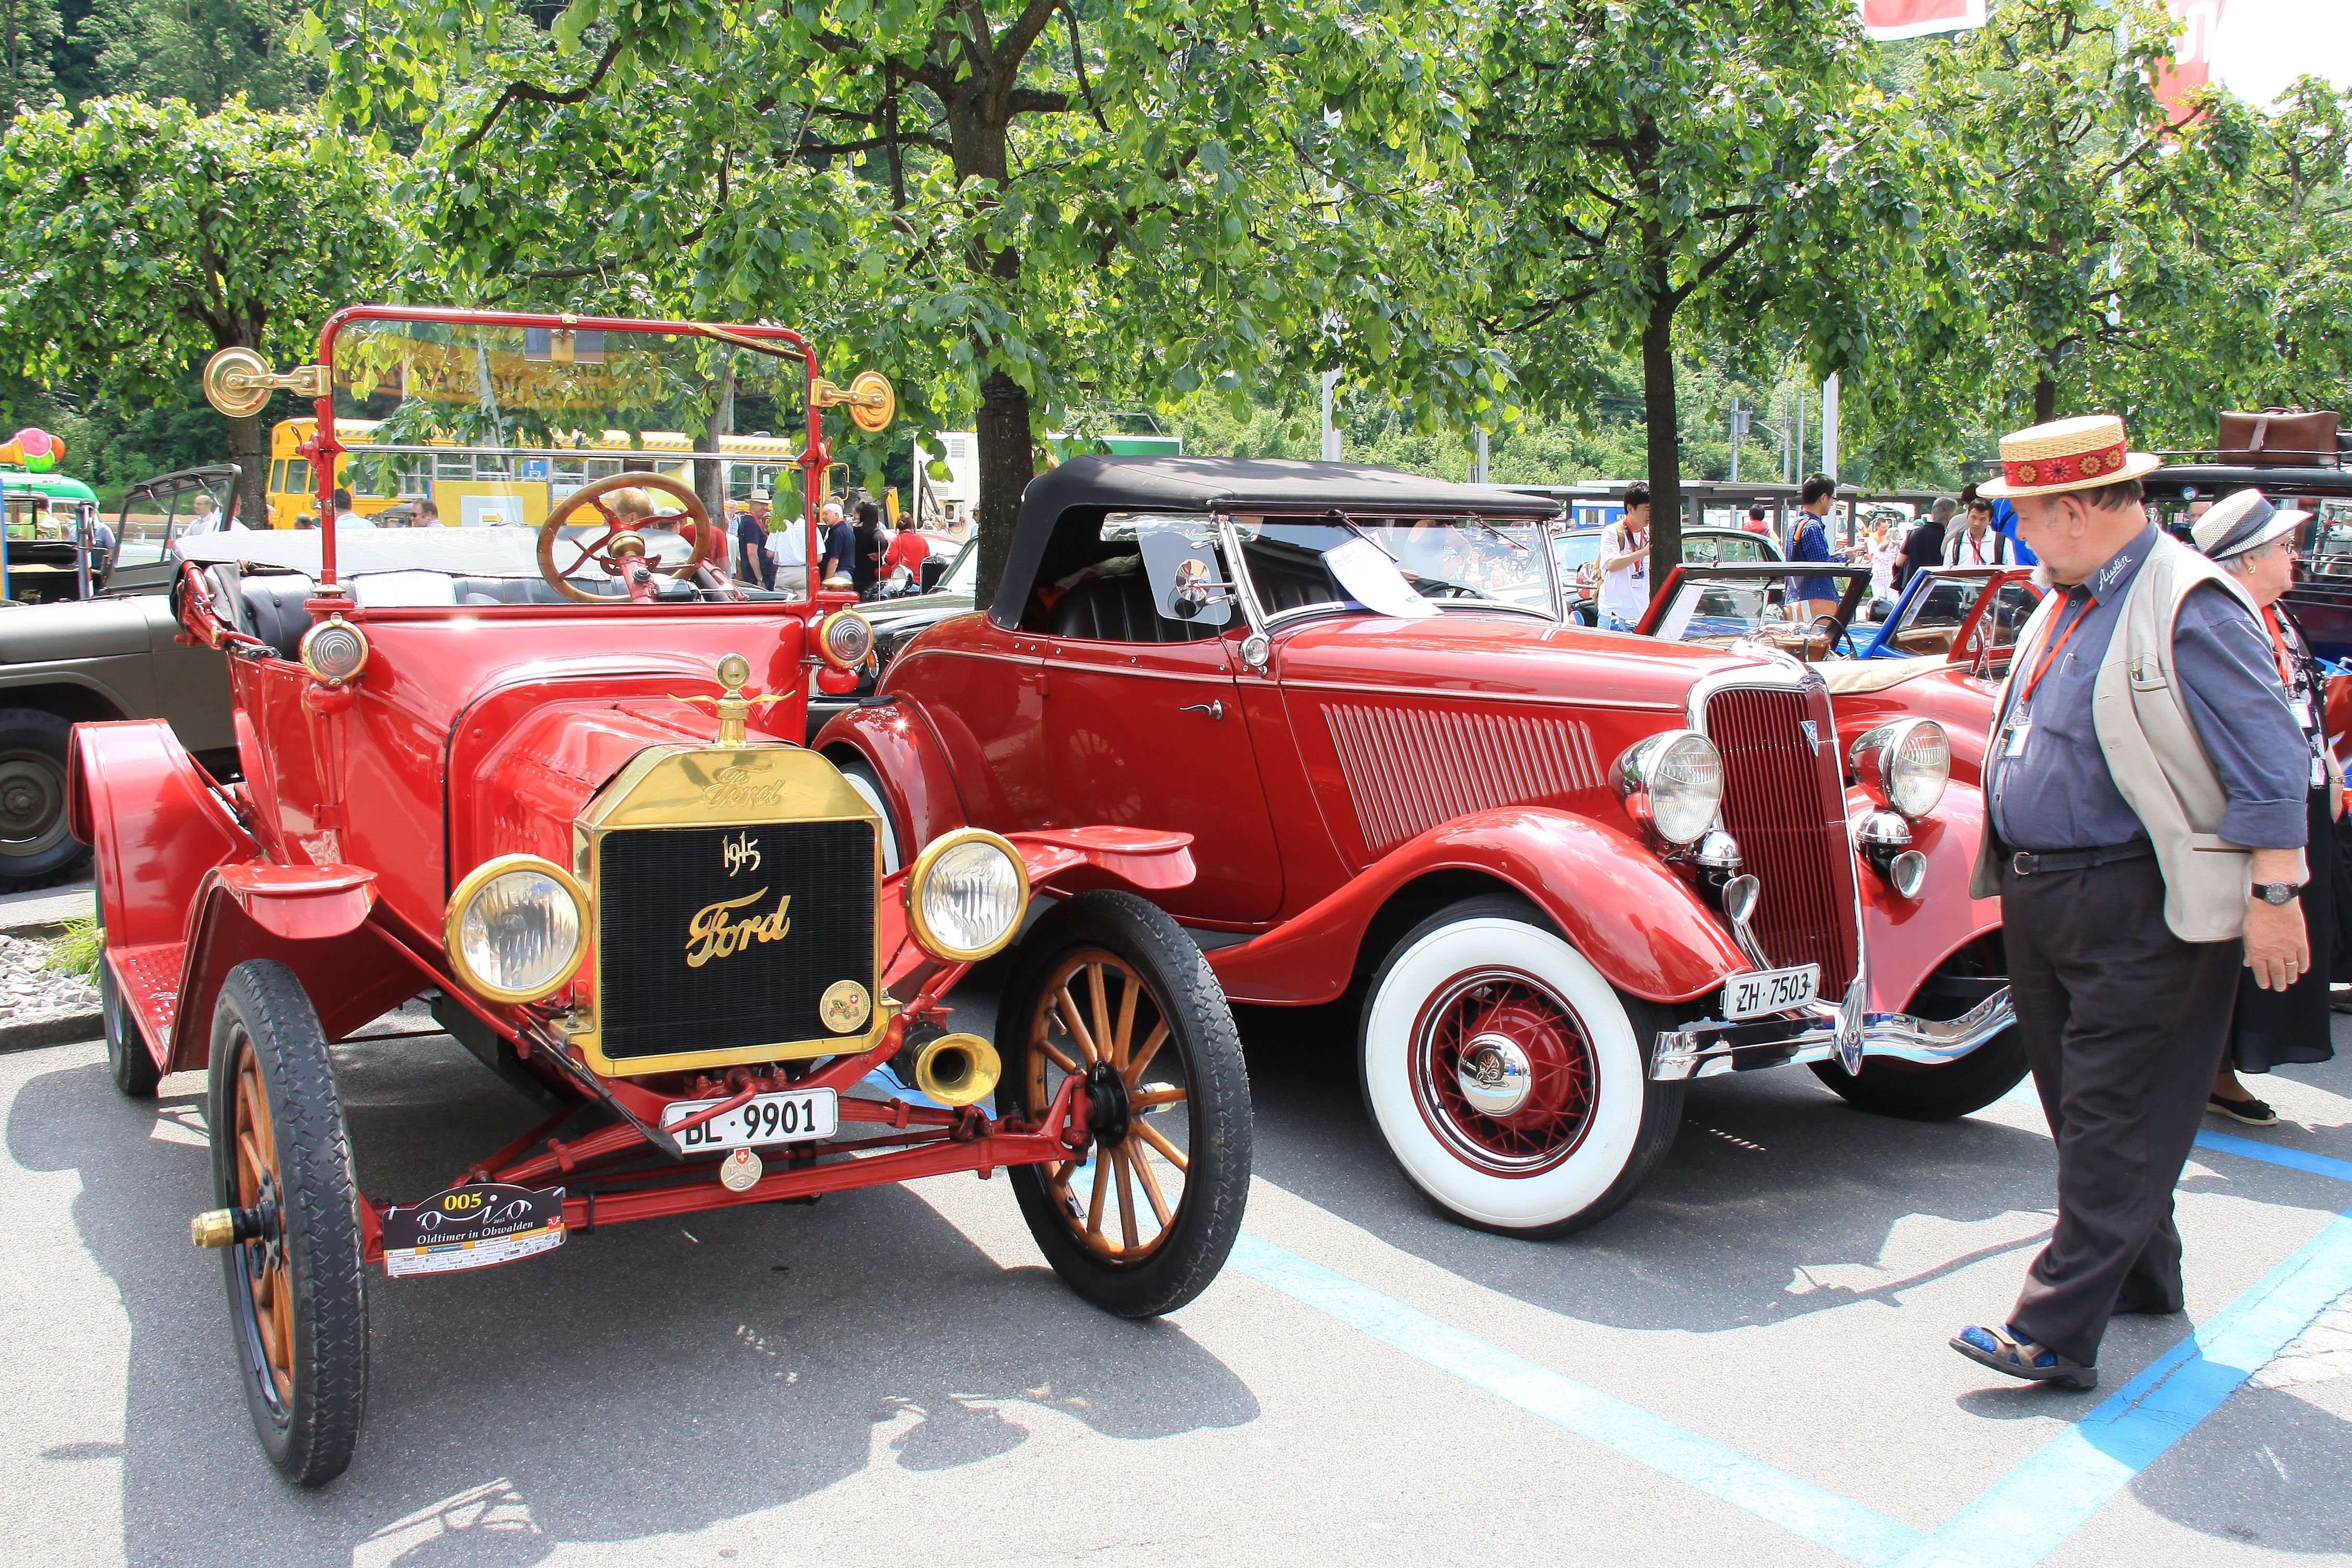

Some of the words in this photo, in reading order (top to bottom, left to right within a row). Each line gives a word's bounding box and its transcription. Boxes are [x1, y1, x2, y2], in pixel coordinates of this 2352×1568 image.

[2098, 554, 2132, 592] Austin
[703, 763, 786, 809] Ford
[721, 830, 761, 877] 1915
[684, 885, 791, 968] Ford
[443, 1190, 483, 1211] 005
[417, 1231, 465, 1245] Oldtimer
[468, 1230, 479, 1240] in
[482, 1220, 534, 1237] Obwalden
